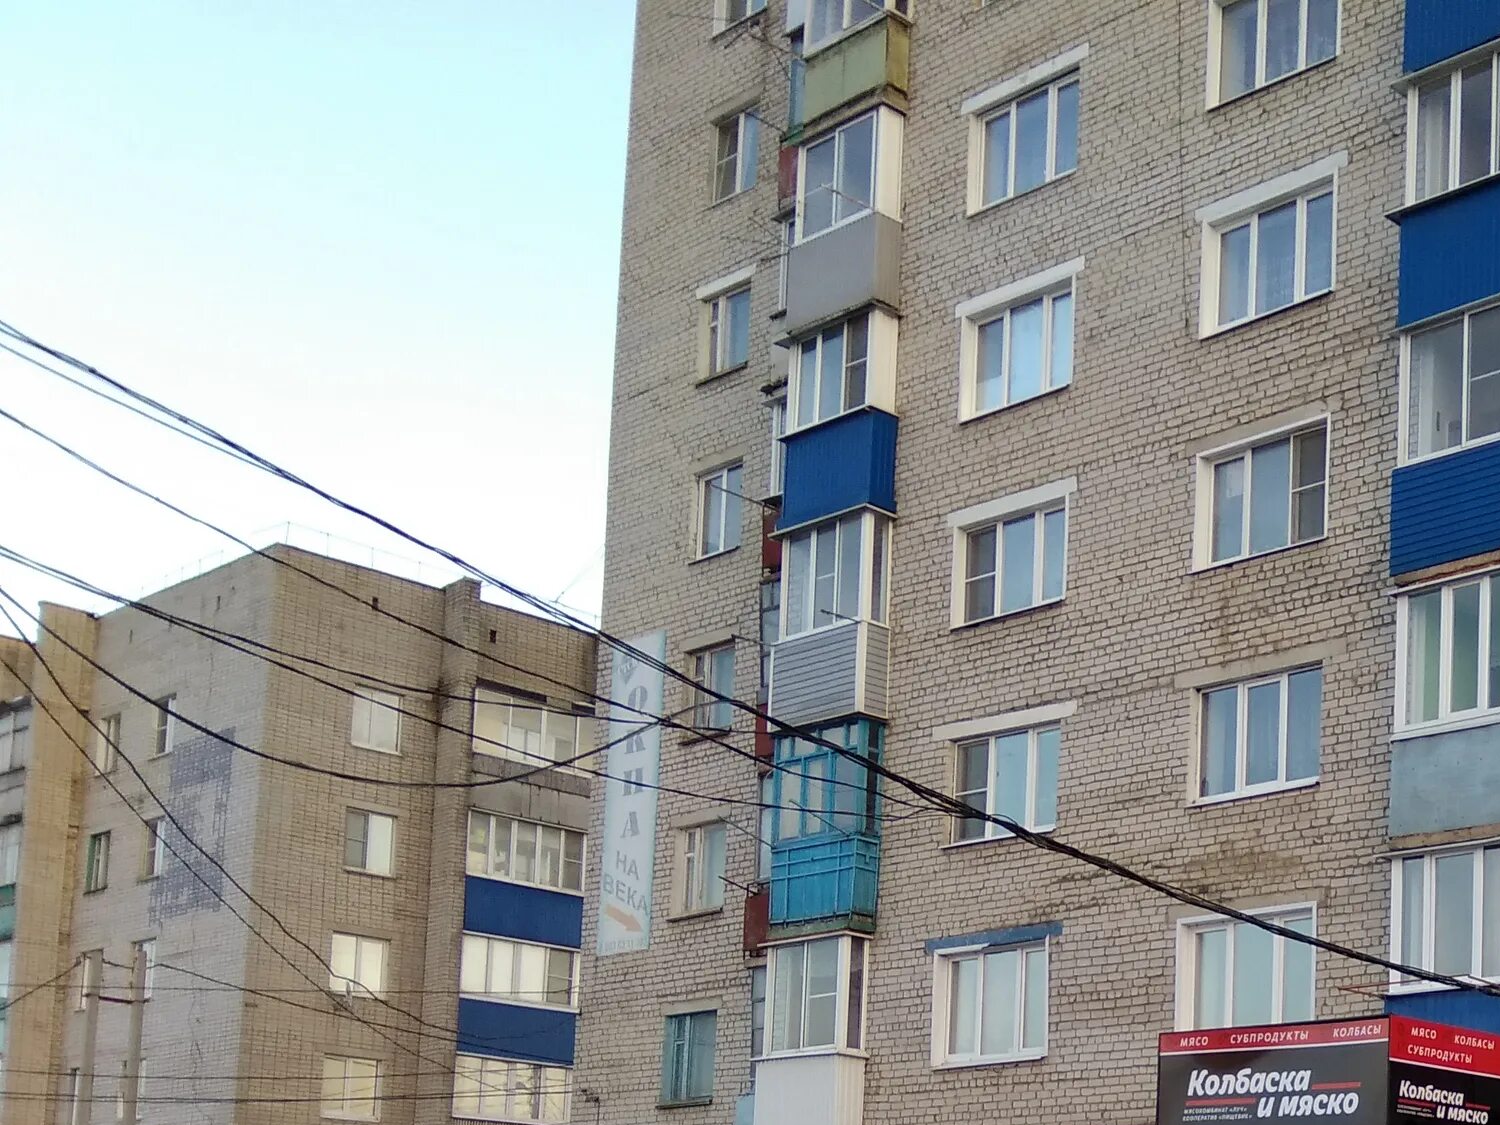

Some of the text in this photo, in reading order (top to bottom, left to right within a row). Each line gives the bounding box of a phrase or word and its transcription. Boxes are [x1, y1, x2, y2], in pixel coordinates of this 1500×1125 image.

[615, 850, 640, 880] НА
[602, 873, 650, 917] ВЕКА
[1179, 1024, 1382, 1047] МЯСО СУБПРОДУКТЫ КОЛБАСЫ
[1411, 1027, 1495, 1050] МЯСО КОЛБАСЫ
[1407, 1044, 1473, 1064] СУБПРОДУКТЫ
[1187, 1067, 1312, 1097] Колбаска
[1398, 1079, 1465, 1107] Колбаска
[1257, 1092, 1359, 1118] и мяско
[1436, 1106, 1446, 1119] и
[1447, 1106, 1489, 1125] мяско
